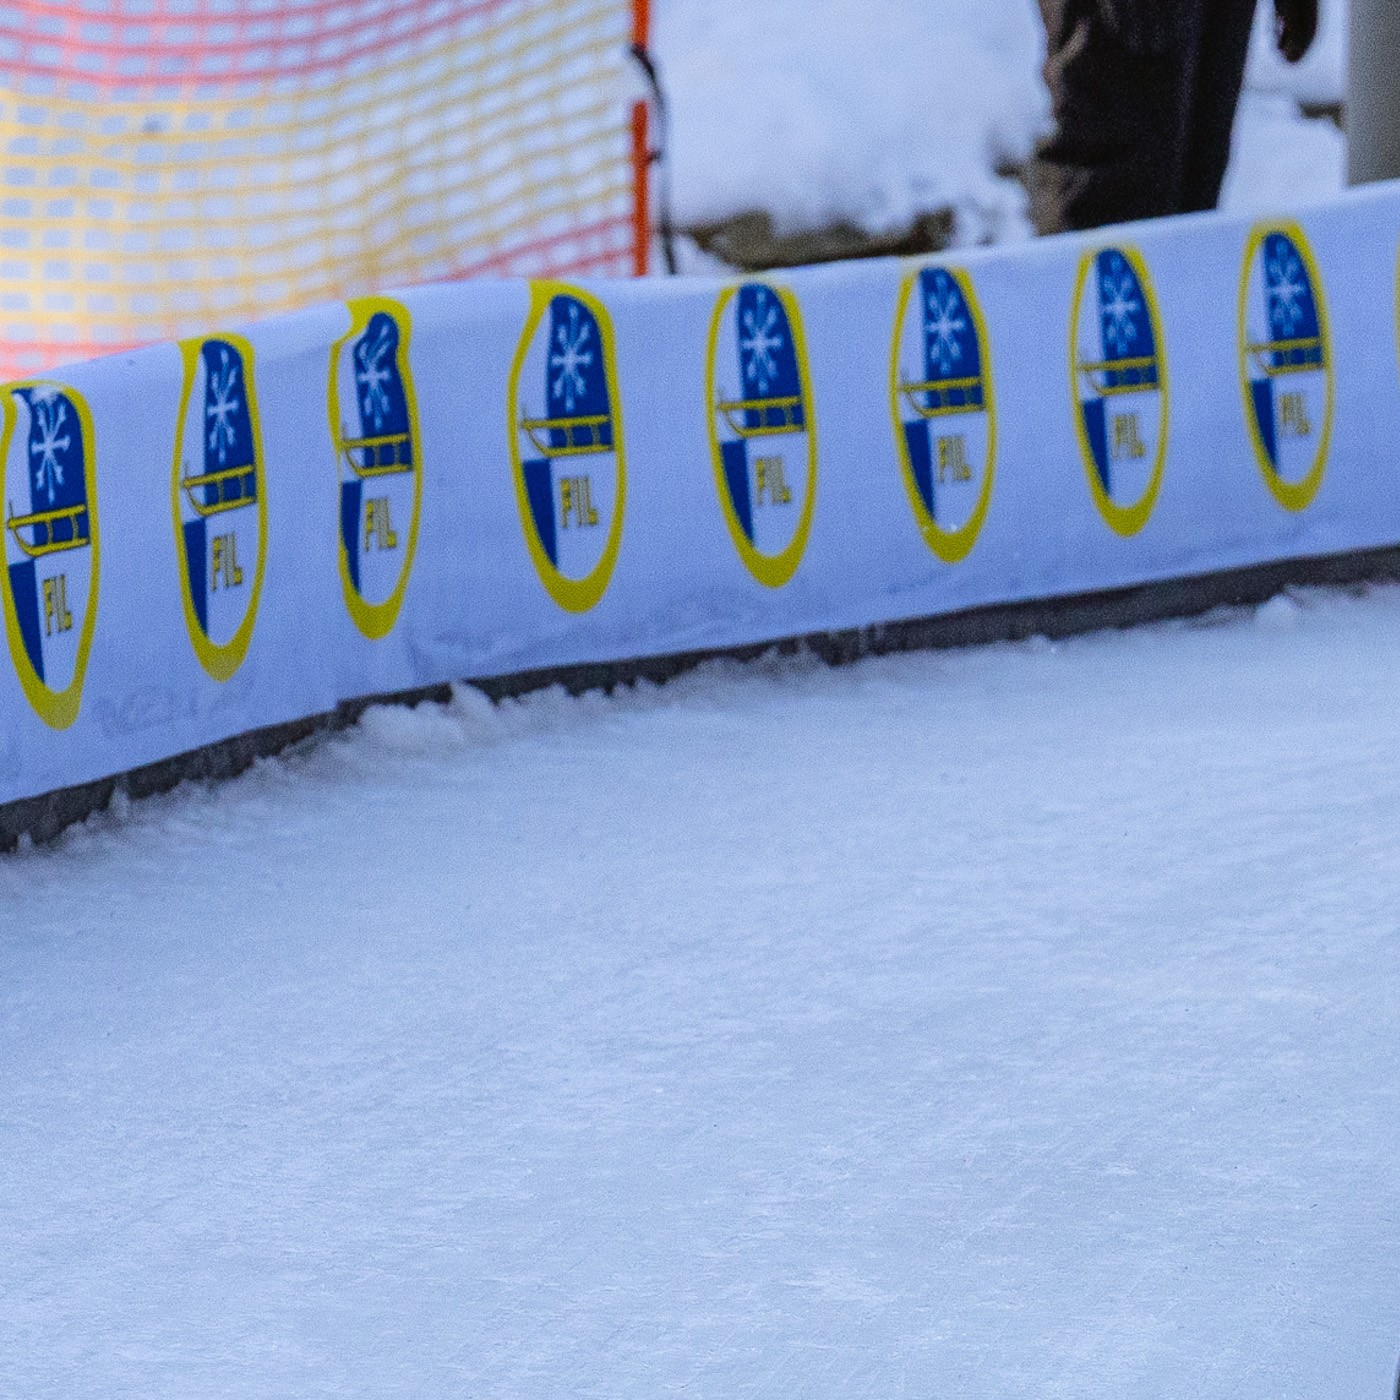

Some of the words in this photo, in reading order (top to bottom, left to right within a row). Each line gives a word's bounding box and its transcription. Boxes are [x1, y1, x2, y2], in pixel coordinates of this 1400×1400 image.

[1113, 414, 1146, 459] FIL
[1278, 394, 1312, 435] FIL
[755, 456, 792, 505] FIL
[937, 435, 972, 482] FIL
[363, 498, 397, 551] FIL
[559, 476, 599, 528] FIL
[210, 533, 244, 591] FIL
[42, 574, 73, 637] FIL
